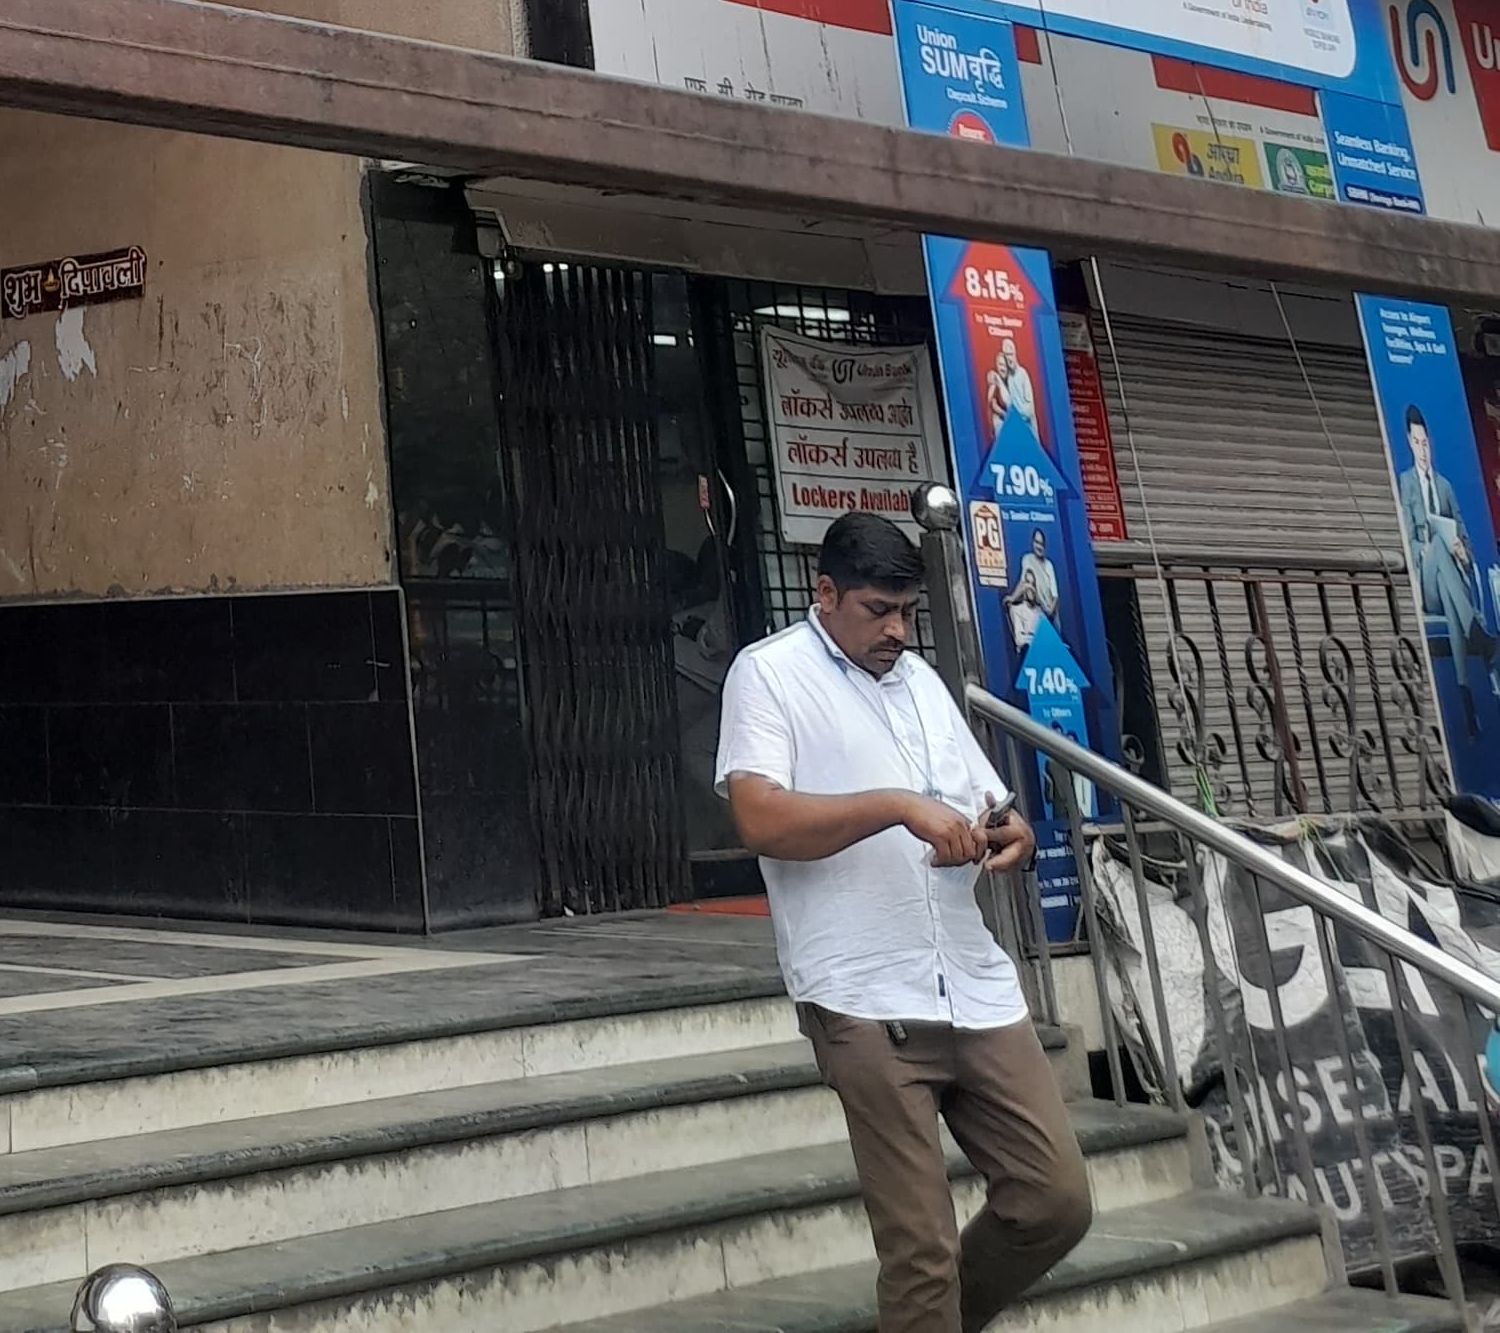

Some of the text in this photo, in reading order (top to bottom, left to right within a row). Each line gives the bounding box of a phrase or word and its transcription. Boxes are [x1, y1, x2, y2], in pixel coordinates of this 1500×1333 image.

[916, 23, 957, 50] Union
[1334, 130, 1373, 150] Seamless
[1337, 151, 1386, 175] Unmatched
[1386, 162, 1417, 181] Service
[3, 270, 42, 318] शुभ
[964, 266, 1025, 303] 8.15%
[905, 441, 919, 474] है
[792, 482, 856, 510] Lockers
[991, 463, 1054, 500] 7.90%
[1024, 667, 1078, 696] 7.40%
